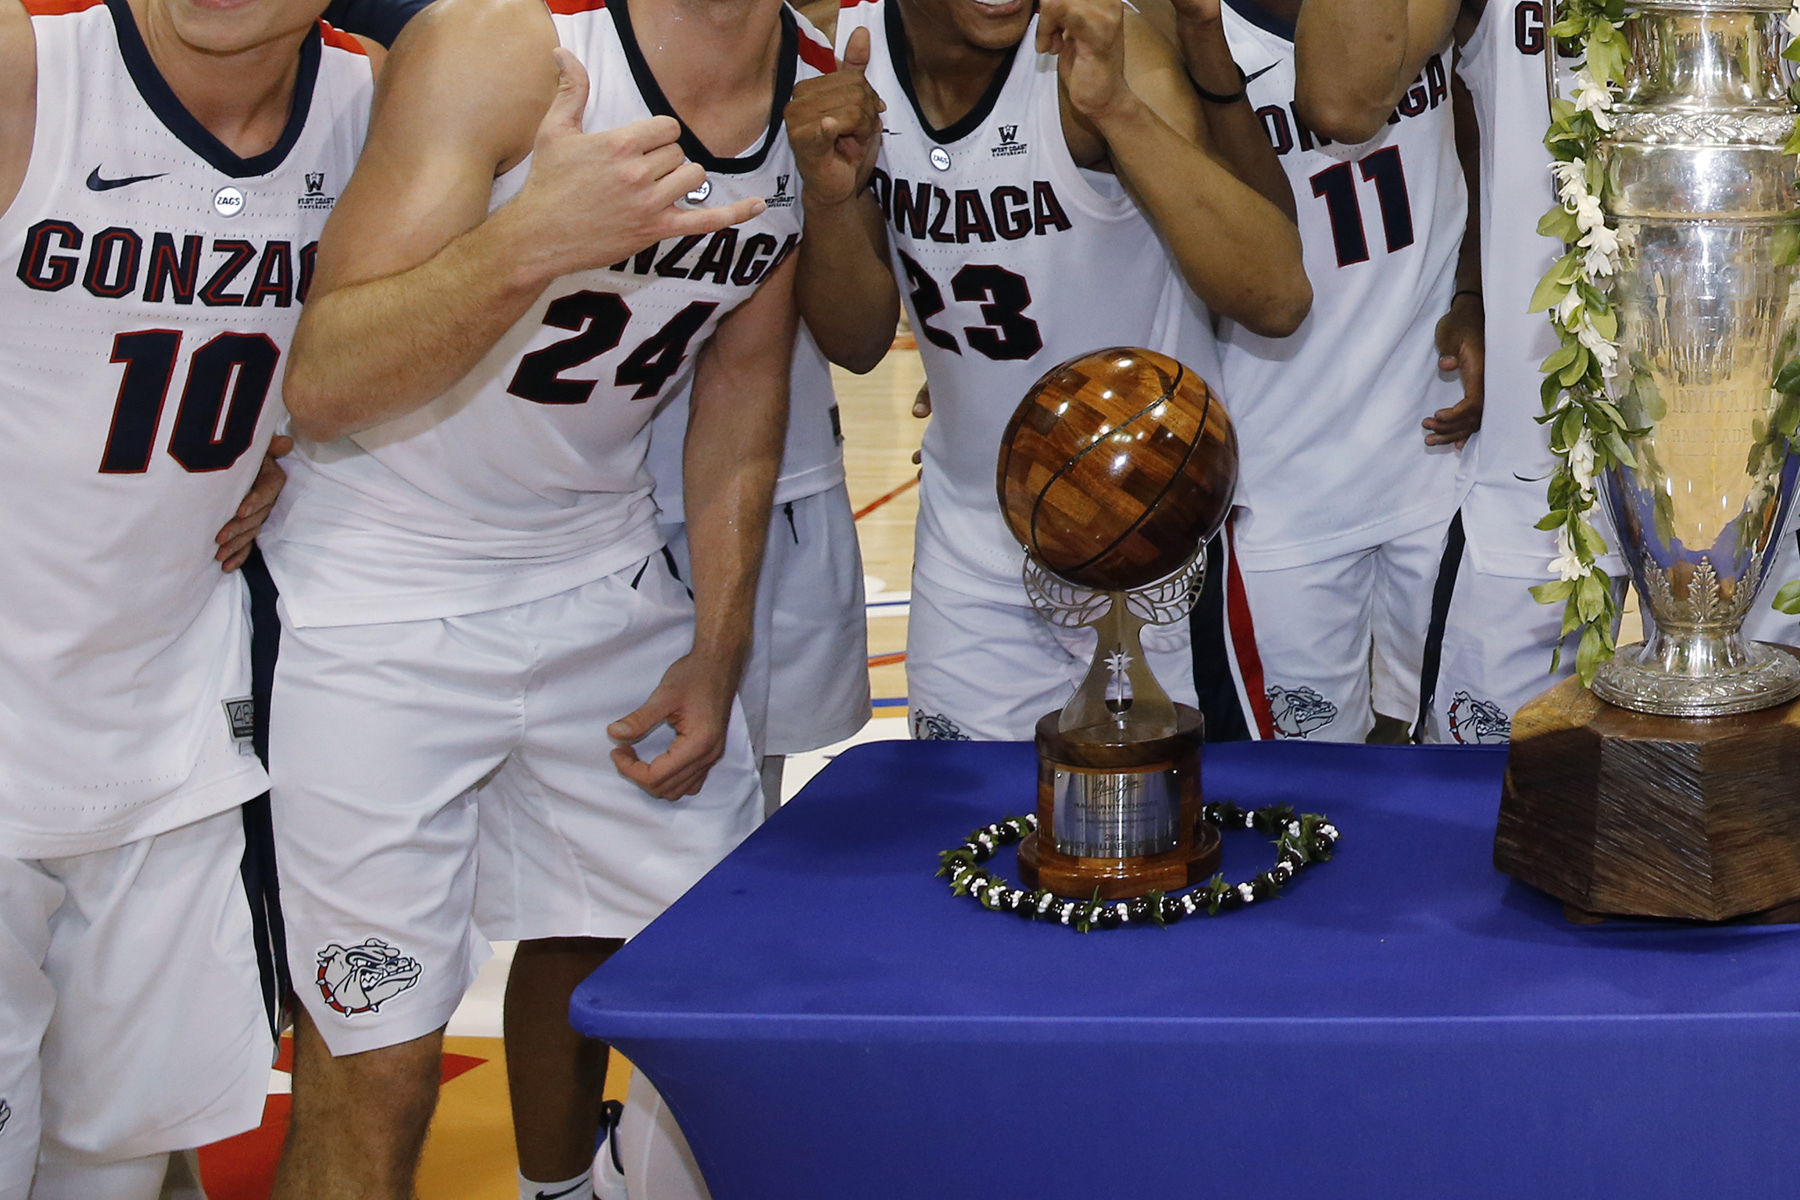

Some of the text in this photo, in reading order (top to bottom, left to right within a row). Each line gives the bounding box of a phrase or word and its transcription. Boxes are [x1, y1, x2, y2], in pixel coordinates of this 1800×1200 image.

[216, 195, 241, 207] ZAGS
[868, 166, 1072, 244] ONZAGA
[1310, 144, 1414, 268] 11
[507, 290, 719, 405] 24
[898, 247, 1044, 360] 23
[98, 328, 281, 474] 10
